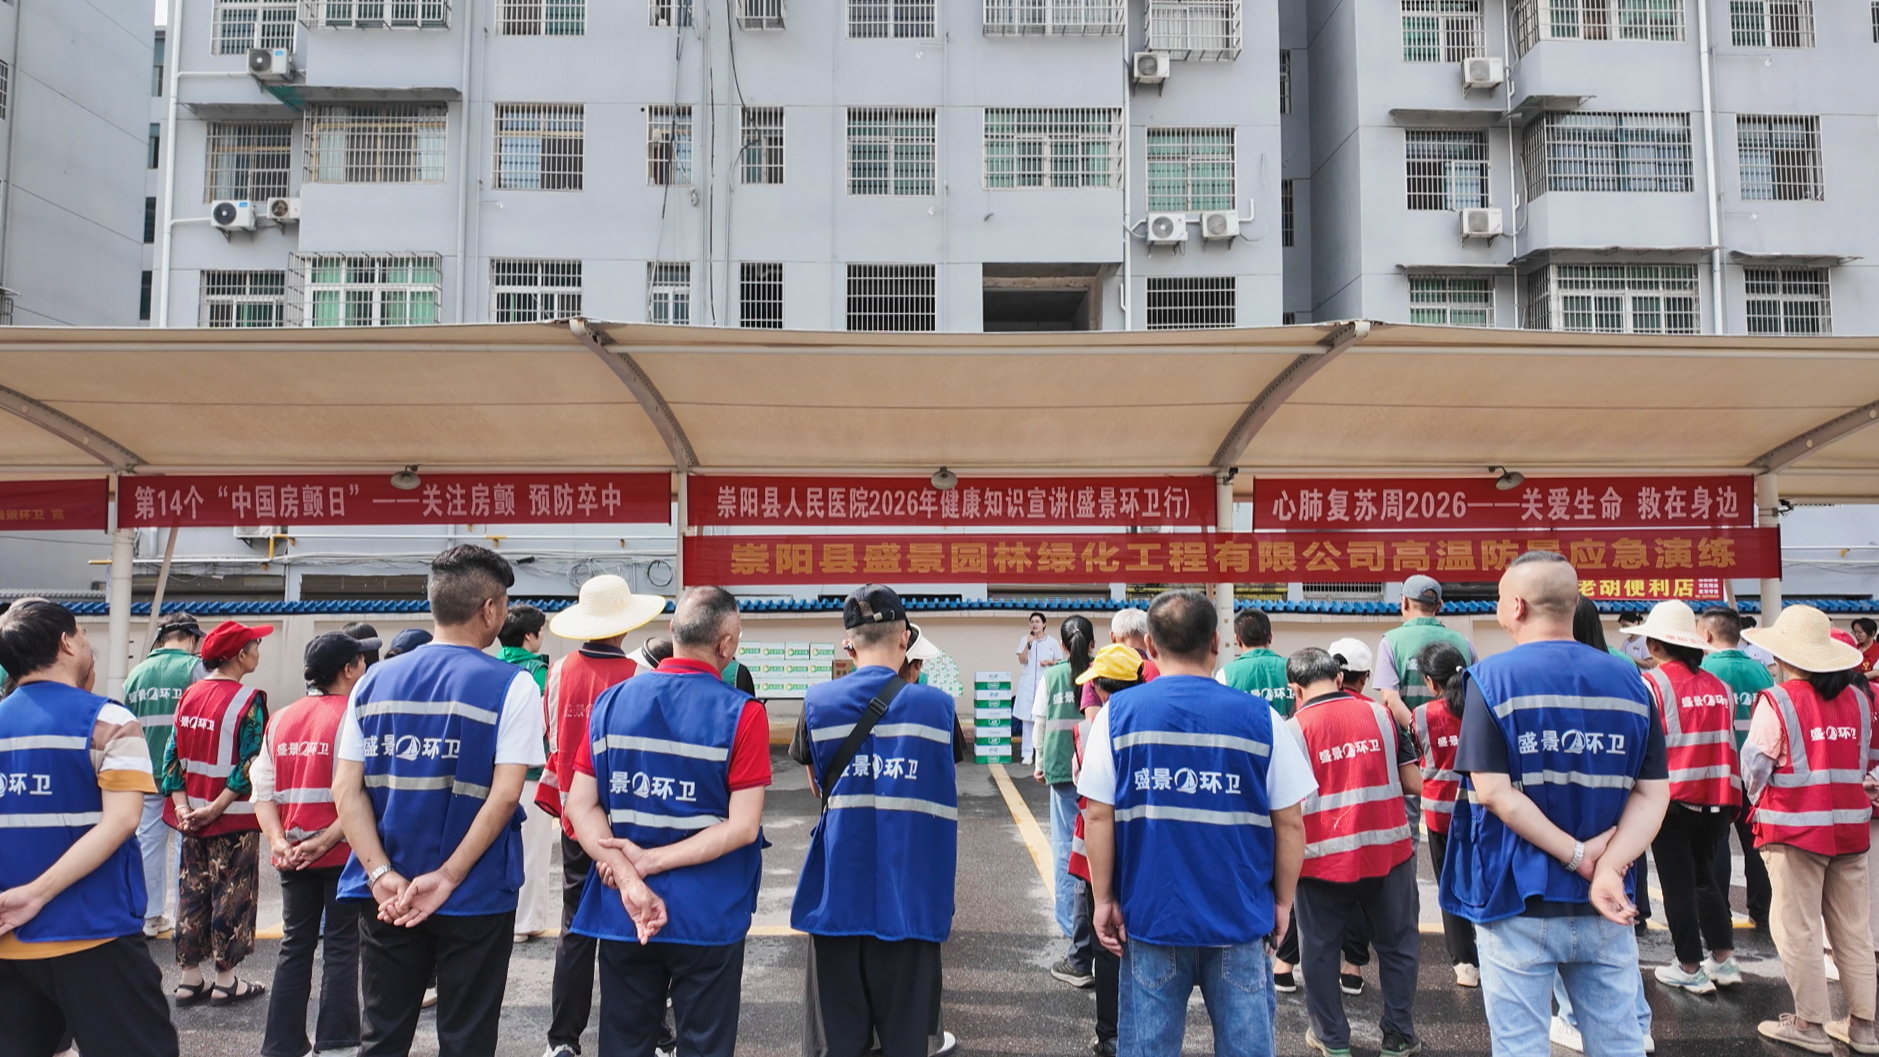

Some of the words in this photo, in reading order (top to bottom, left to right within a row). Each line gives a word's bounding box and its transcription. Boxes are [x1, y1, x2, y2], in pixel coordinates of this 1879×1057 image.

[134, 485, 204, 520] 第14个
[529, 483, 621, 517] 预防卒中
[717, 486, 1190, 520] 崇阳县人民医院2026年健康知识宣讲(盛景环卫行)
[1272, 486, 1623, 521] 心肺复苏周2026——关爱生命
[1637, 485, 1740, 519] 救在身边
[1578, 579, 1694, 598] 老胡便利店
[1518, 729, 1626, 754] 盛景环卫
[8, 773, 52, 796] 环卫
[1134, 767, 1241, 794] 盛景环卫
